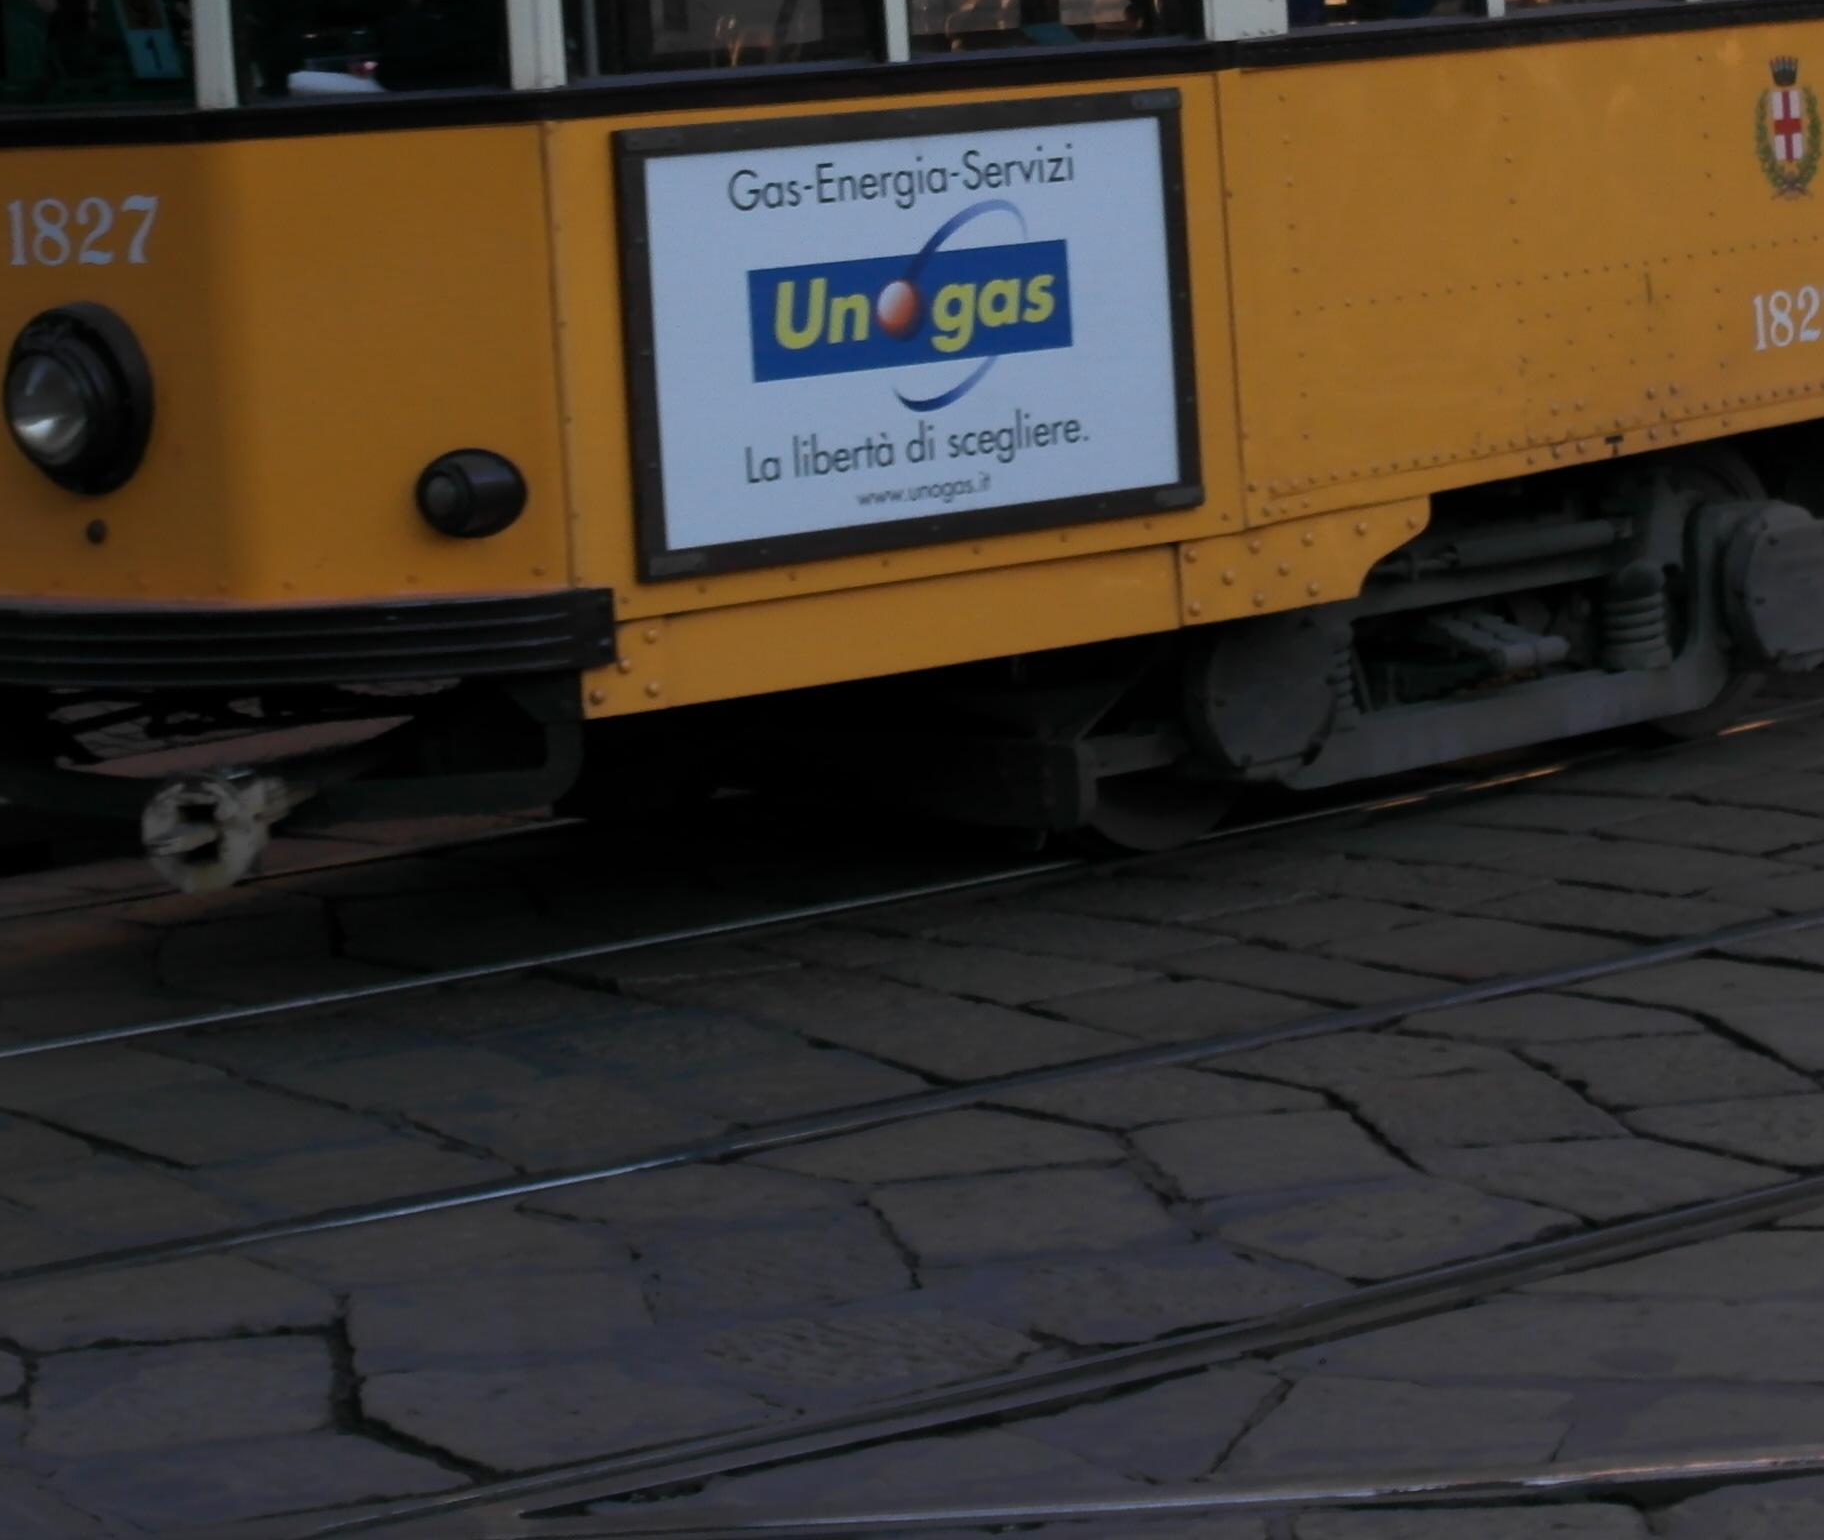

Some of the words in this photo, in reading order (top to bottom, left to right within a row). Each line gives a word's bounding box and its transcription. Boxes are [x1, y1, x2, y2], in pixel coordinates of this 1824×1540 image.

[727, 142, 1075, 213] Gas-Energia-Servizi
[7, 194, 159, 267] 1827
[744, 445, 782, 484] La
[792, 432, 896, 479] libertà
[905, 419, 936, 464] di
[948, 408, 1090, 464] scegliere.
[856, 472, 992, 507] www.unogas.it
